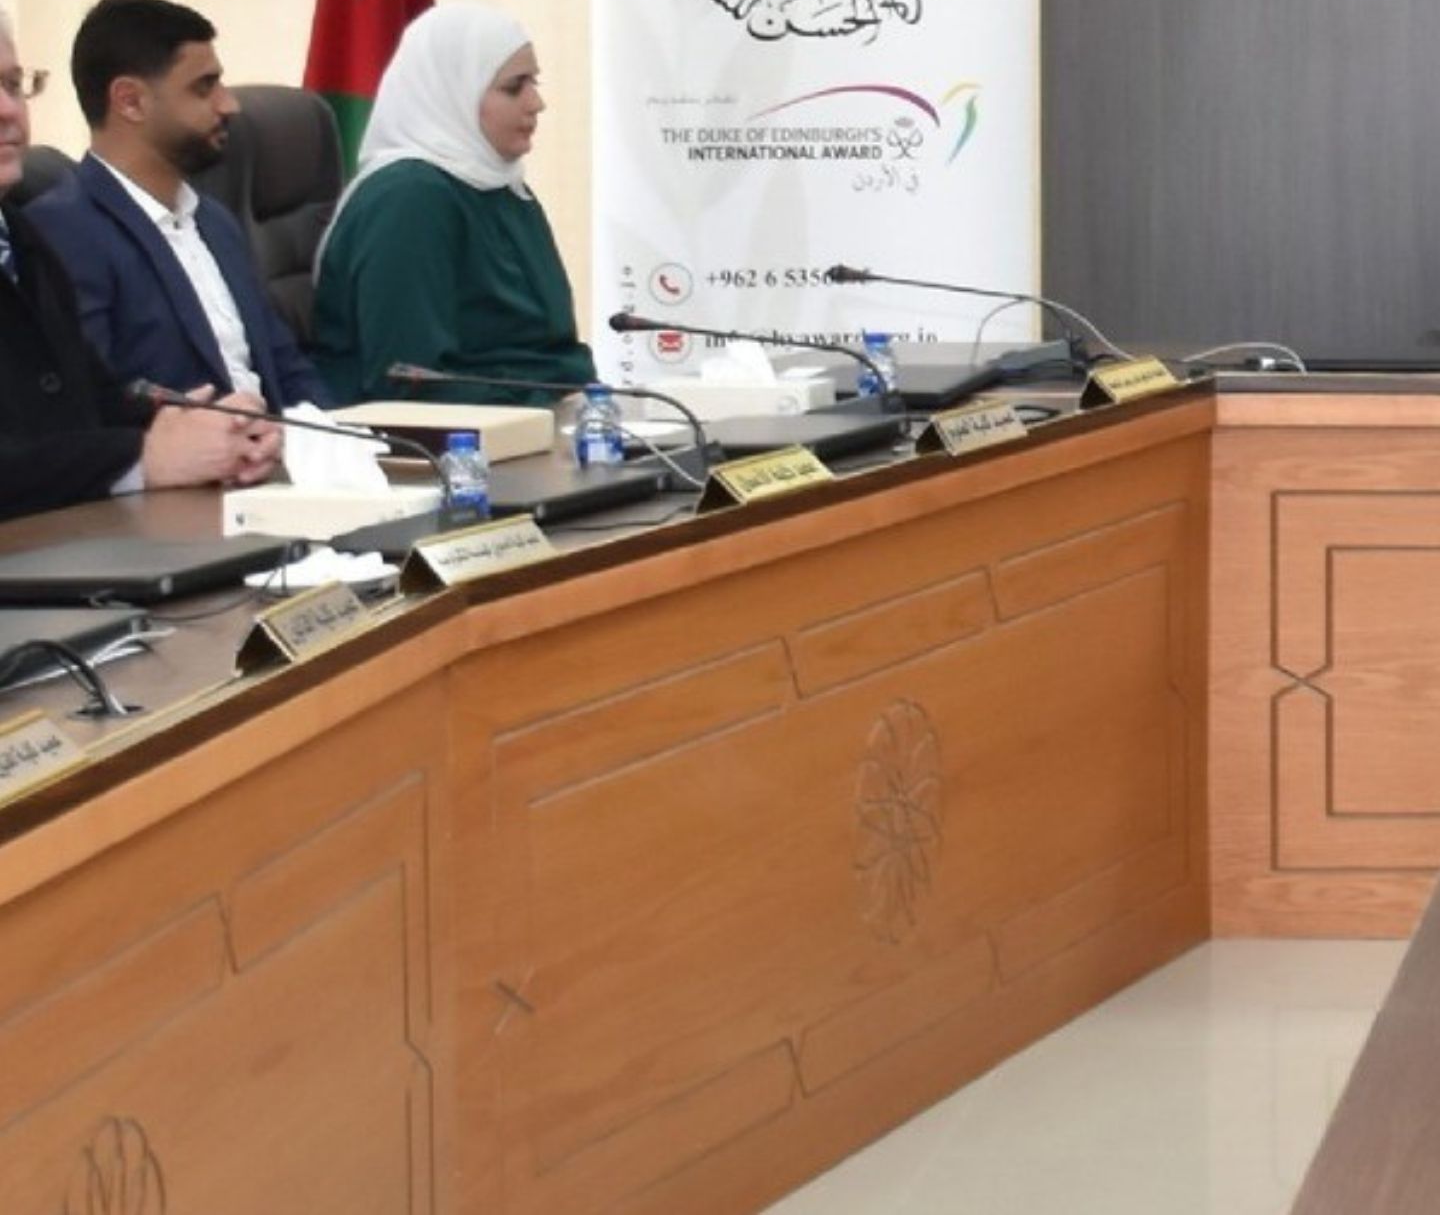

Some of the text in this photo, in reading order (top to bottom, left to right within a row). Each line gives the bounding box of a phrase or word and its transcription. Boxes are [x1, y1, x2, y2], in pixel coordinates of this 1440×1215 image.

[662, 127, 882, 143] THE DUKE OF EDINBURGH'S
[688, 145, 882, 160] INTERNATIONAL AWARD
[706, 269, 757, 286] +962
[765, 269, 777, 286] 6
